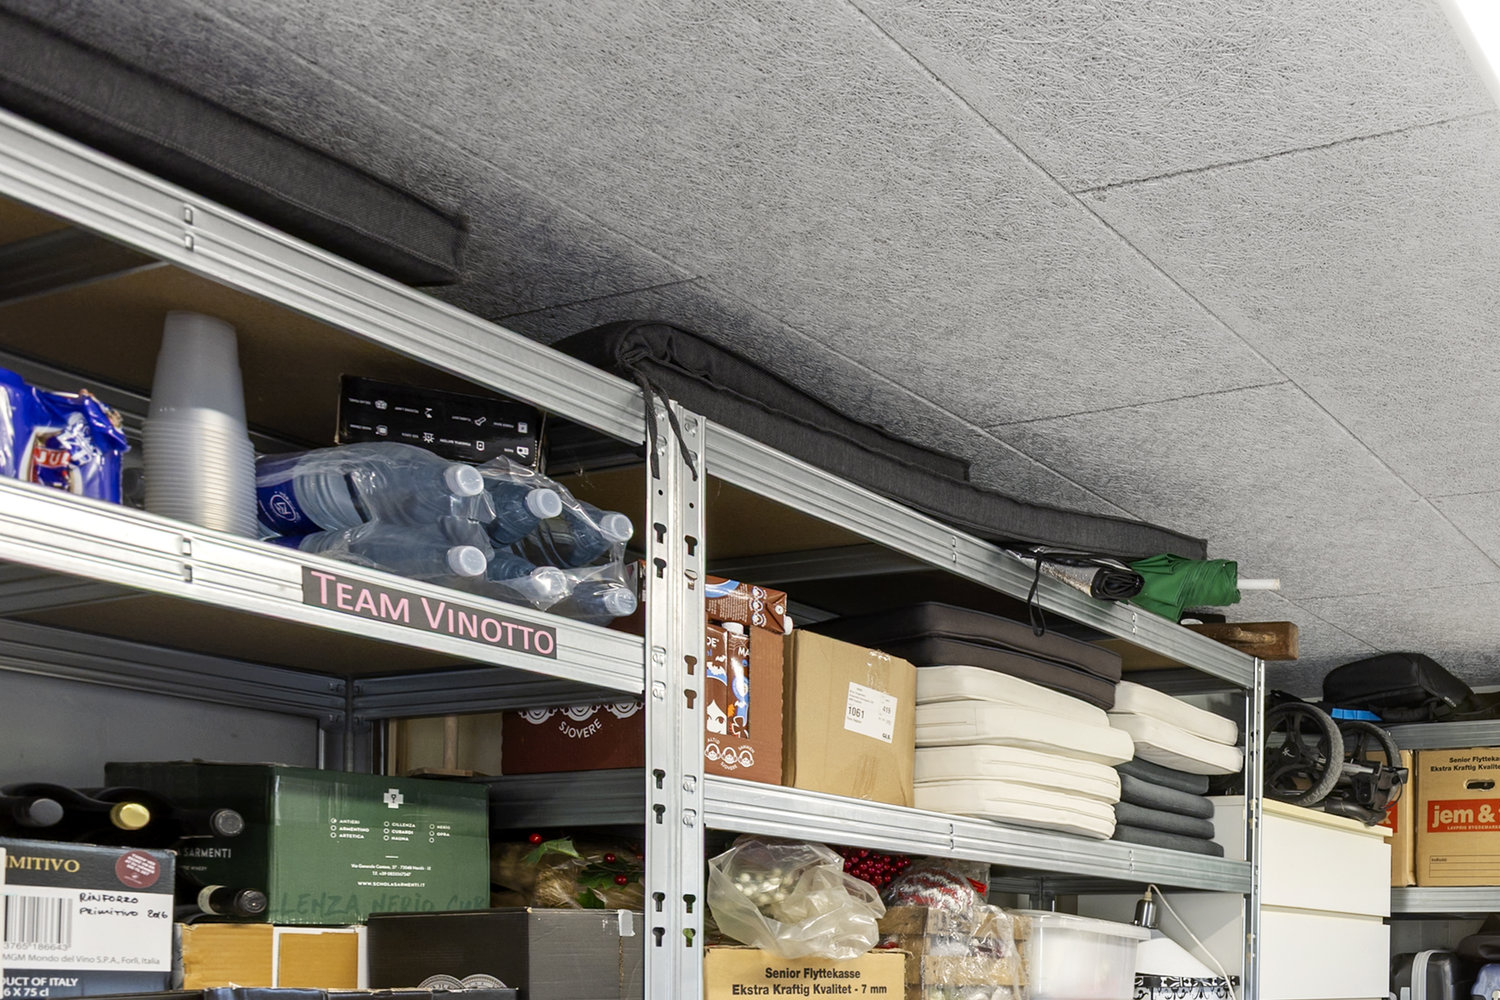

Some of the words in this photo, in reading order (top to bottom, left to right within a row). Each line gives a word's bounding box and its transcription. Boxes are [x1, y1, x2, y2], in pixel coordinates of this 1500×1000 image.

[311, 571, 410, 623] TEAM
[421, 597, 554, 655] VINOTTO
[559, 718, 602, 738] SJOVERE
[1432, 805, 1474, 828] jem
[1478, 804, 1496, 823] &
[184, 848, 232, 858] SARMENTI
[28, 954, 59, 962] Mondo
[61, 954, 74, 962] del
[76, 955, 95, 963] Vino
[765, 967, 800, 979] Senior
[803, 968, 861, 980] Flyttekasse
[31, 977, 47, 986] OF
[49, 977, 78, 987] ITALY
[4, 987, 11, 996] 6
[25, 988, 37, 996] 75
[39, 987, 49, 996] cl
[732, 984, 769, 995] Ekstra
[773, 984, 810, 996] Kraftig
[813, 984, 852, 994] Kvalitet
[861, 984, 867, 994] 7
[870, 985, 887, 994] mm
